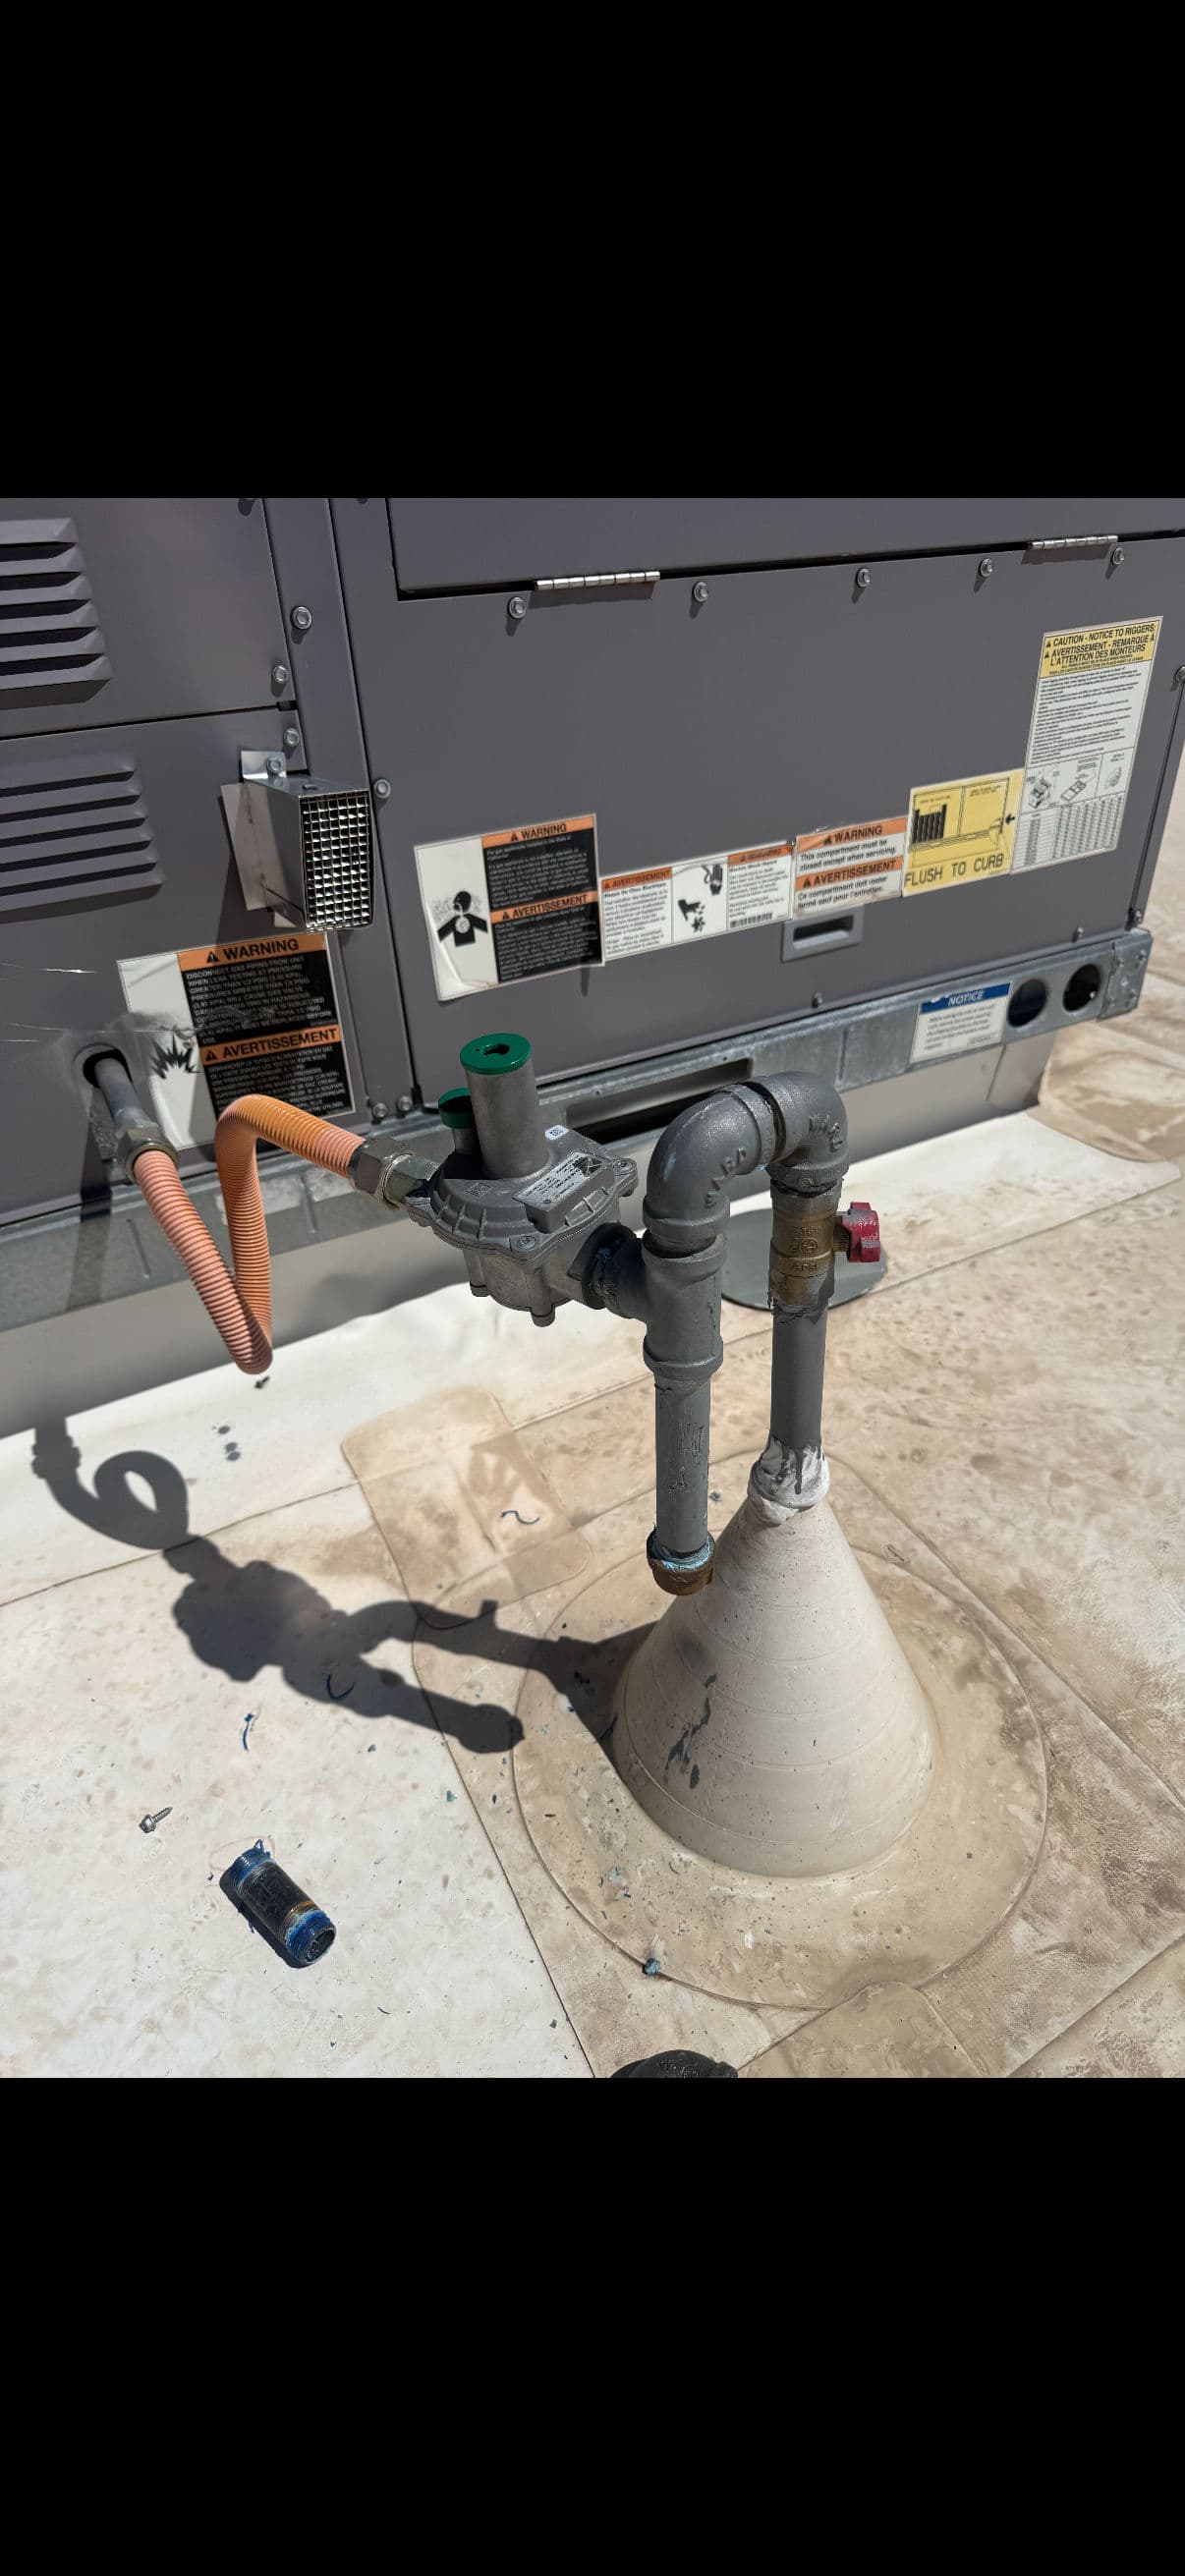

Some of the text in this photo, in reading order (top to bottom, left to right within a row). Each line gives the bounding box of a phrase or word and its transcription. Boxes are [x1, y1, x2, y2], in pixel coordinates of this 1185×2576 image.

[1053, 635, 1084, 646] CAUTION
[1089, 630, 1113, 642] NOTICE
[1115, 628, 1124, 637] TO
[1125, 624, 1156, 636] RIGGERS:
[1050, 644, 1146, 666] L'ATTENTION DES MONTEURS
[1051, 642, 1107, 657] AVERTISSEMENT
[1112, 635, 1149, 648] REMARQUE
[521, 823, 567, 839] WARNING
[834, 825, 882, 842] WARNING
[800, 861, 821, 871] closed
[823, 857, 845, 868] except
[847, 854, 864, 863] when
[801, 853, 815, 862] This
[817, 846, 860, 860] compartment
[613, 870, 671, 886] AVERTISSEMENT
[814, 860, 896, 885] AVERTISSEMENT
[904, 853, 1004, 888] FLUSH TO CURB
[513, 895, 588, 918] AVERTISSEMENT
[223, 939, 299, 960] WARNING
[186, 967, 229, 980] DISCONNECT
[948, 990, 984, 1006] NOTICE
[223, 1029, 337, 1058] AVERTISSEMENT
